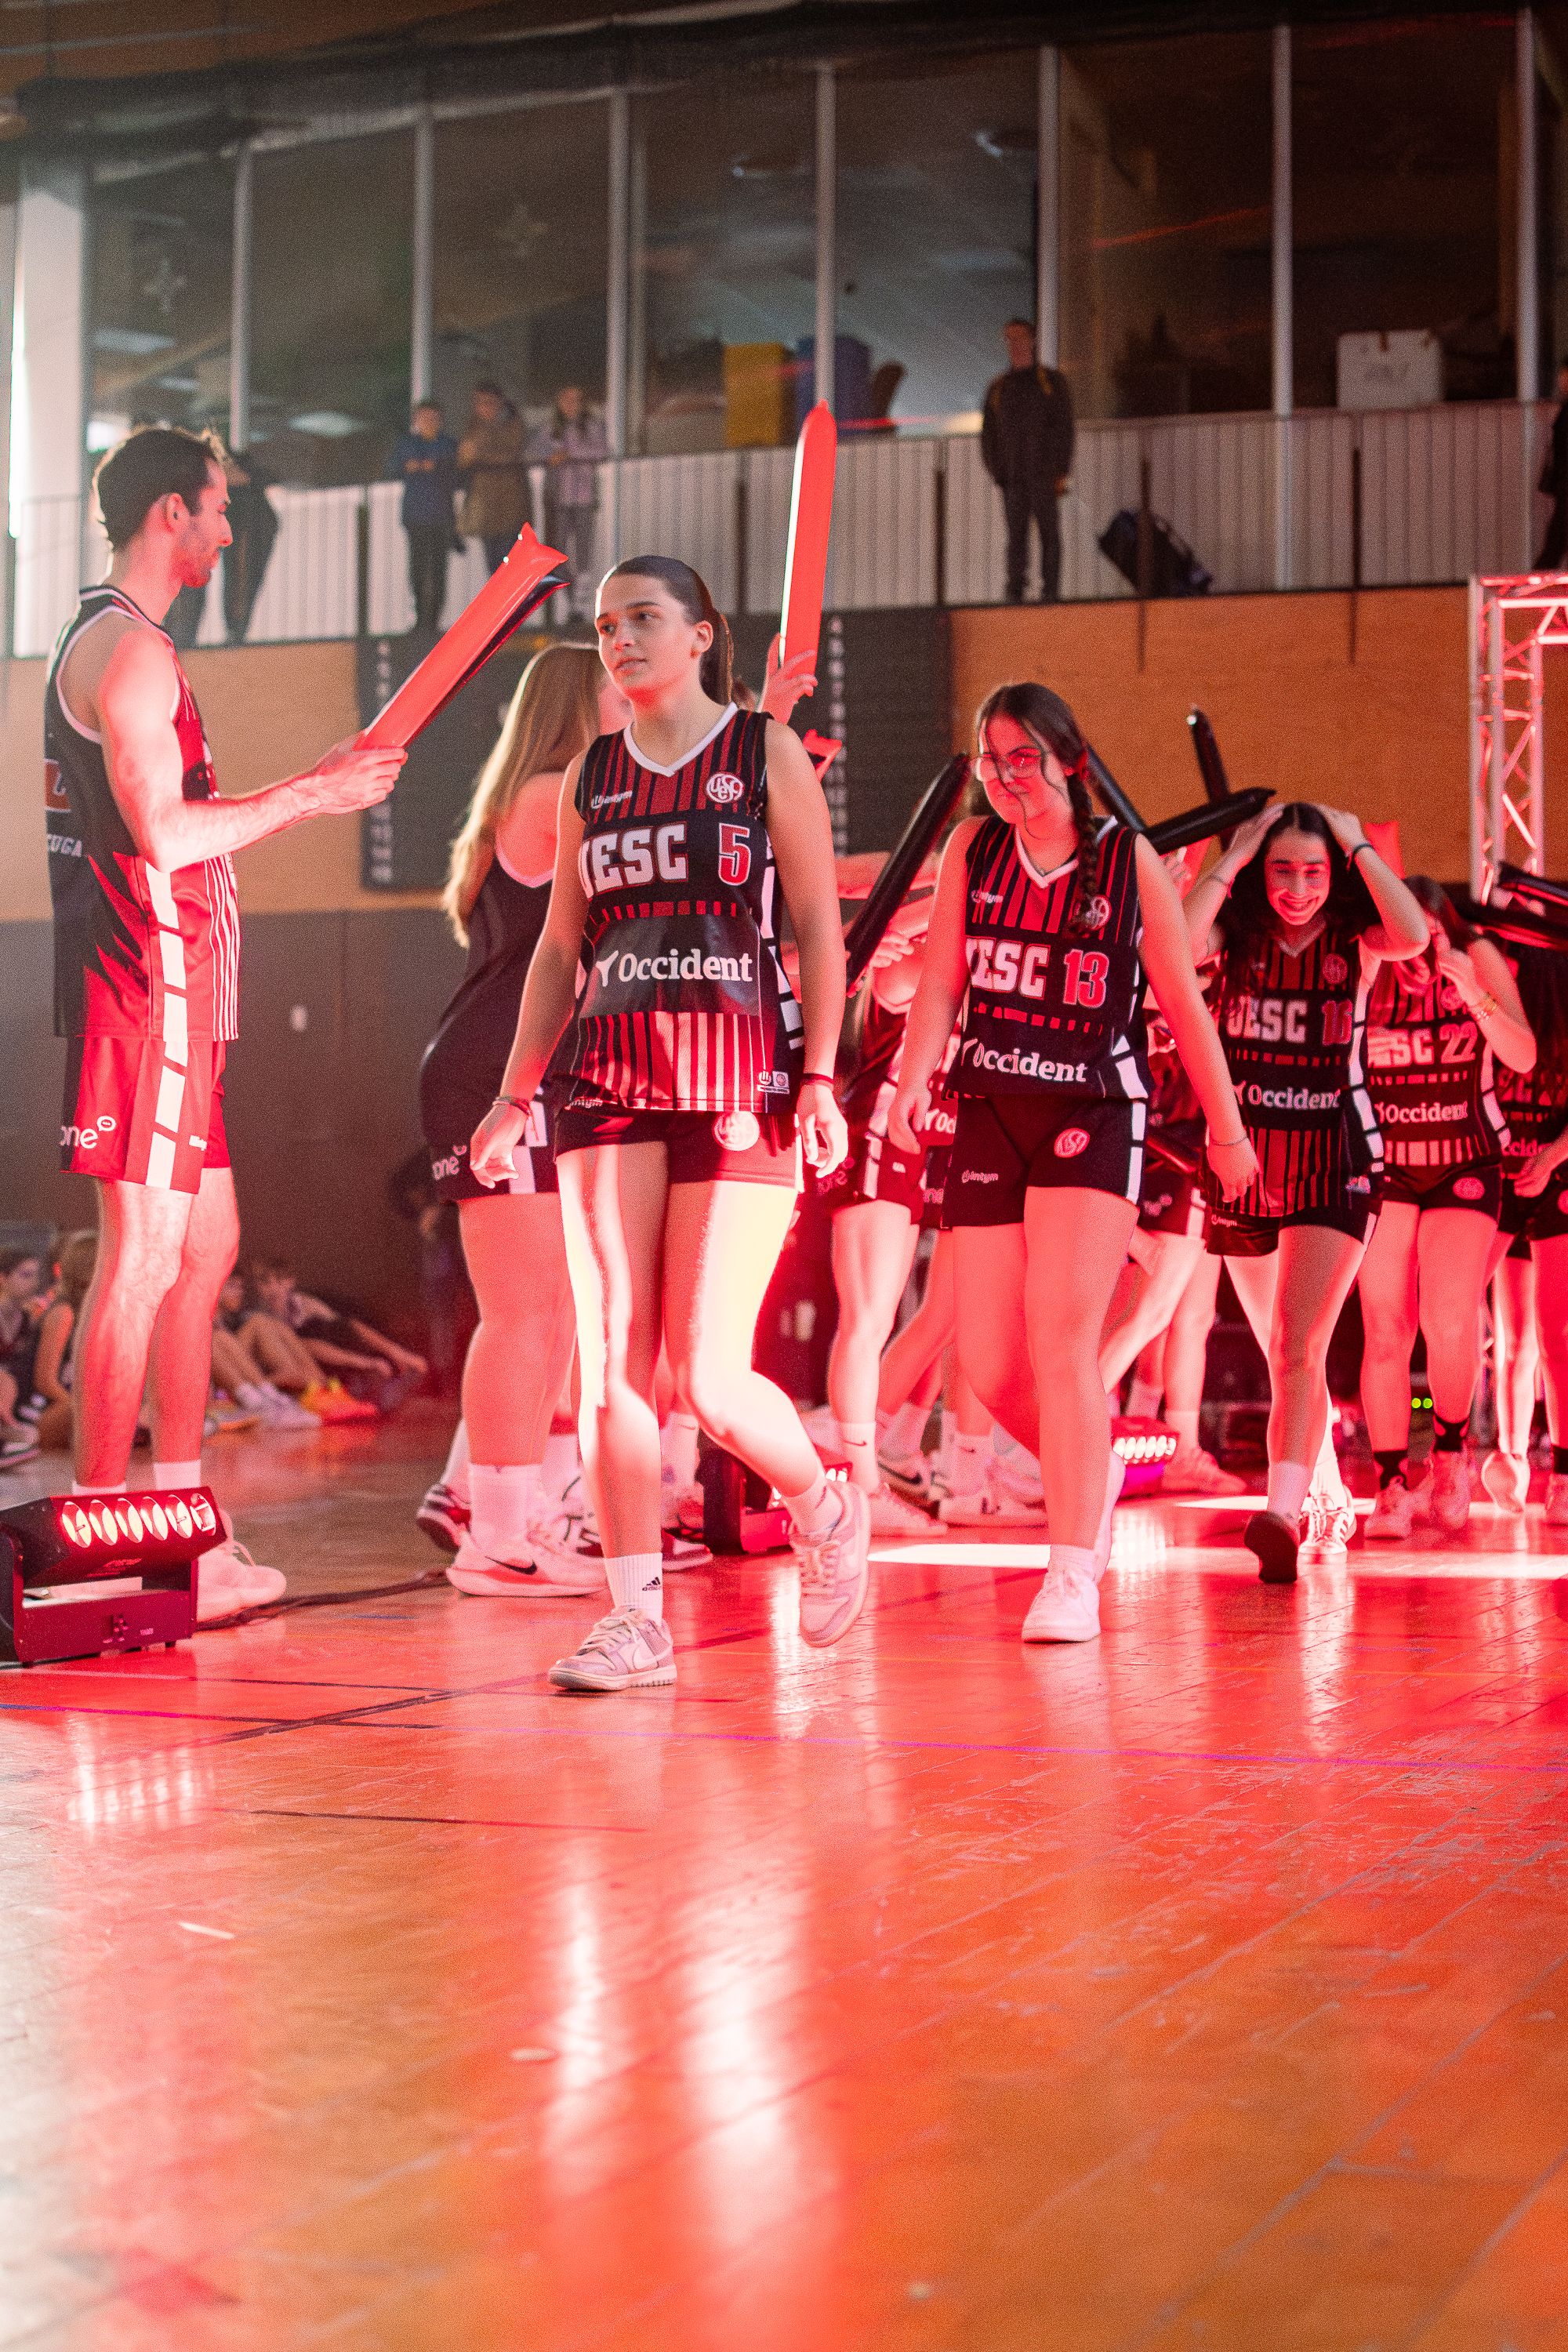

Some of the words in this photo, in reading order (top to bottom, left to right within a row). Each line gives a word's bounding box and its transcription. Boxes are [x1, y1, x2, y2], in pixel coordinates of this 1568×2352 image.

[719, 823, 751, 886] 5
[618, 949, 753, 982] Occident
[1063, 949, 1109, 1008] 13
[972, 1042, 1087, 1083] Occident
[1367, 1026, 1434, 1068] ESC
[1439, 1021, 1478, 1064] 22
[1248, 1086, 1341, 1110] Occident
[1385, 1101, 1468, 1123] Occident
